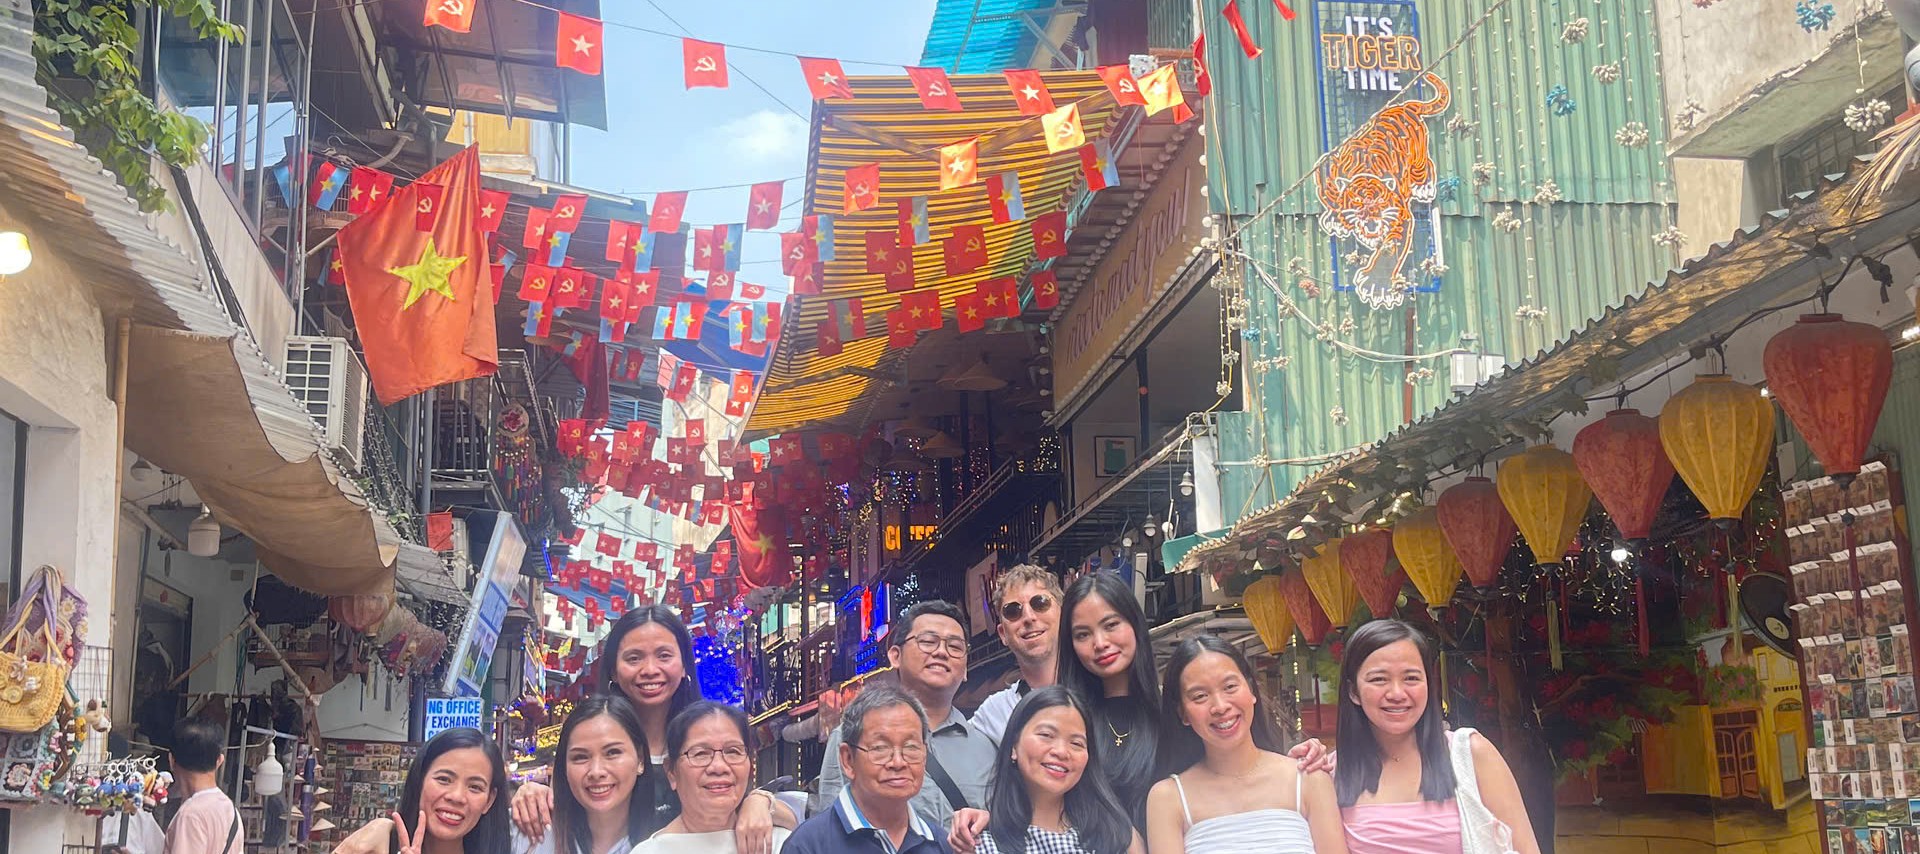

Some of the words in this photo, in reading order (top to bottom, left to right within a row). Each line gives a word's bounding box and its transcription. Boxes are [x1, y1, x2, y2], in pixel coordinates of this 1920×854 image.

[1345, 16, 1393, 37] IT'S
[1320, 33, 1421, 70] TIGER
[1343, 66, 1402, 91] TIME
[446, 700, 480, 714] OFFICE
[431, 715, 480, 729] EXCHANGE
